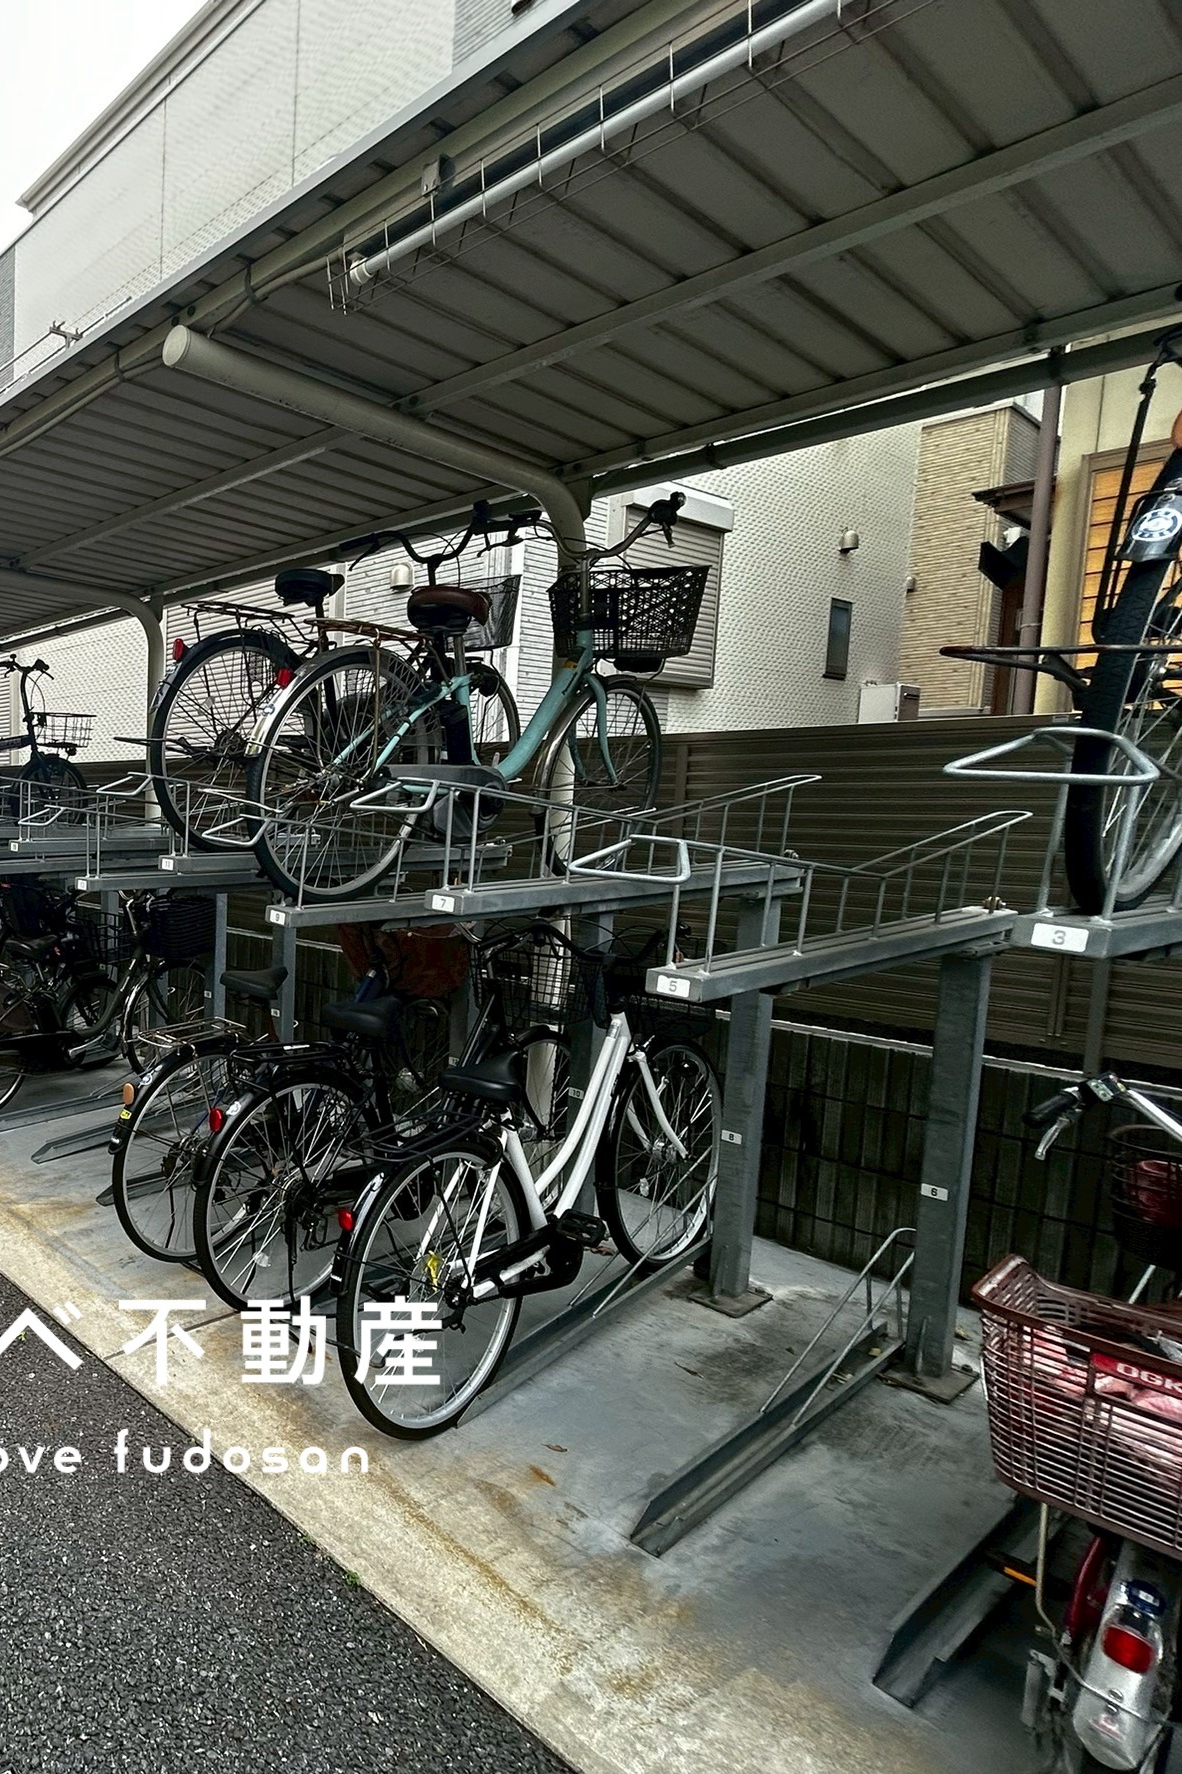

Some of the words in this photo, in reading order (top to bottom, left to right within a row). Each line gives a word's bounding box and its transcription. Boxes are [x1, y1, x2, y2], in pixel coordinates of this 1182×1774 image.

[440, 898, 447, 908] 7
[1052, 929, 1067, 946] 3
[669, 980, 678, 993] 5
[728, 1133, 735, 1141] 8
[931, 1187, 938, 1197] 6
